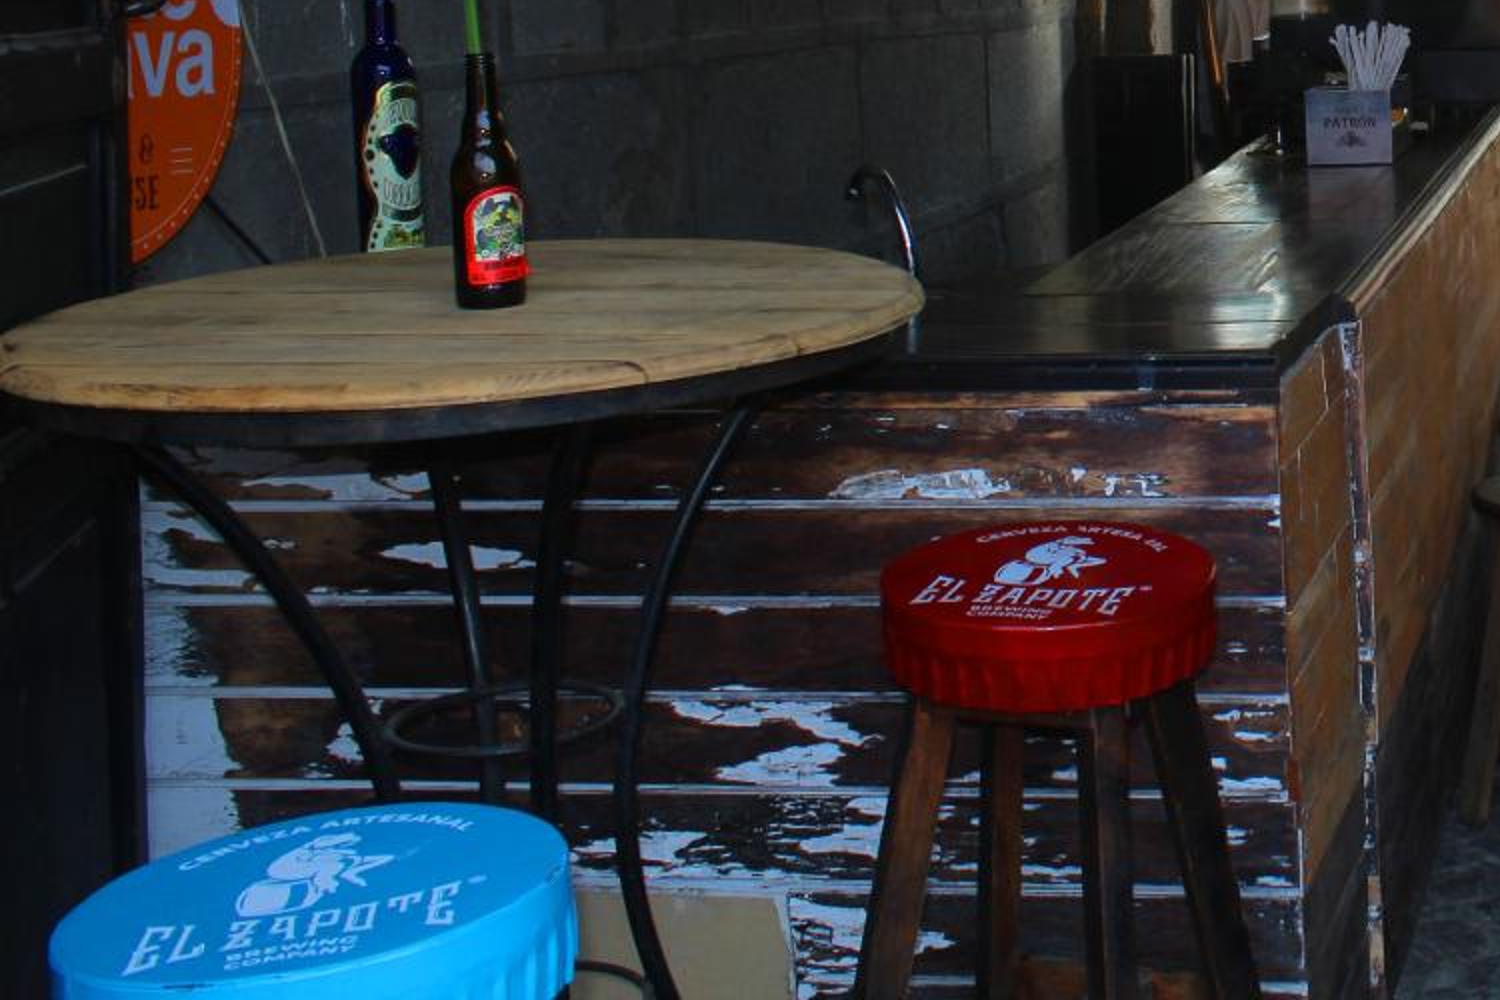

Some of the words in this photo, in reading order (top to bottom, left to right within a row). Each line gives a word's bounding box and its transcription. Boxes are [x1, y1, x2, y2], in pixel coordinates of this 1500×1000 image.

[908, 574, 969, 605] EL
[970, 585, 1137, 616] ZAPOTE
[179, 826, 311, 872] CERVEZA
[317, 812, 475, 833] ARTESANAL
[121, 924, 205, 977] EL
[221, 879, 468, 952] ZAPOTE
[223, 944, 358, 971] COMPANY
[225, 936, 360, 963] BREWING
